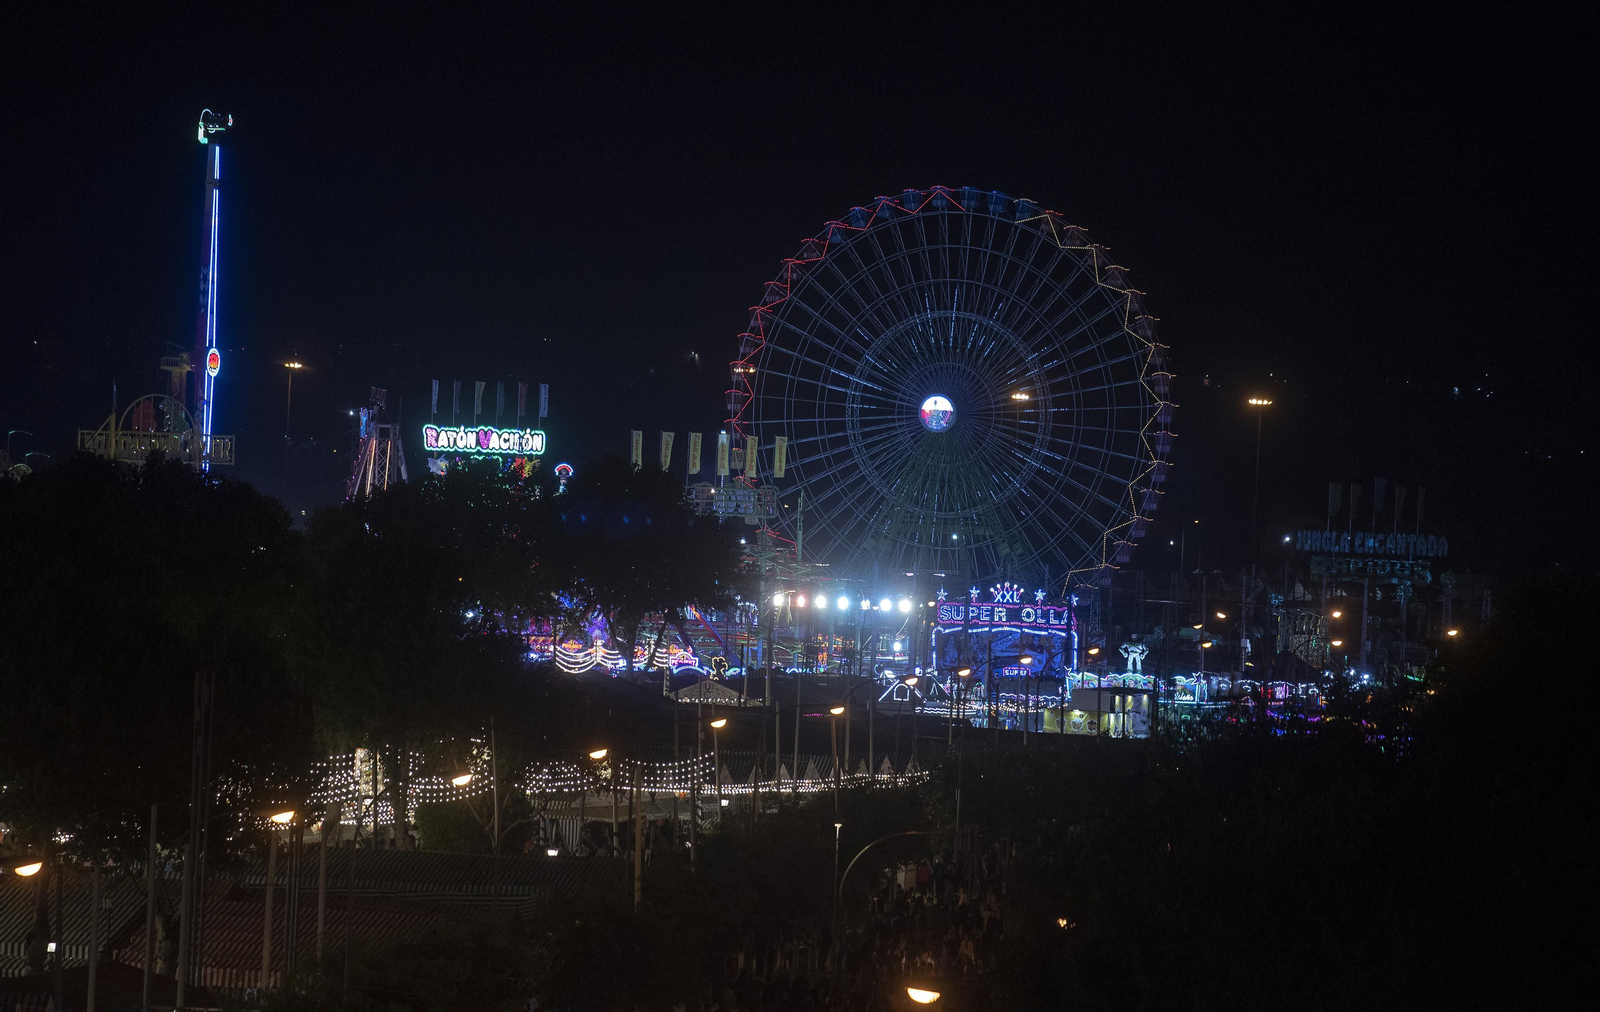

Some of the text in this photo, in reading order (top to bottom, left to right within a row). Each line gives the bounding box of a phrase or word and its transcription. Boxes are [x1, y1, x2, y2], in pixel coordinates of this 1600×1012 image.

[426, 425, 477, 448] RATÓN
[1296, 530, 1448, 557] JUNGLA ENCANTADA
[994, 590, 1020, 603] XXL
[940, 605, 1007, 622] SUPER
